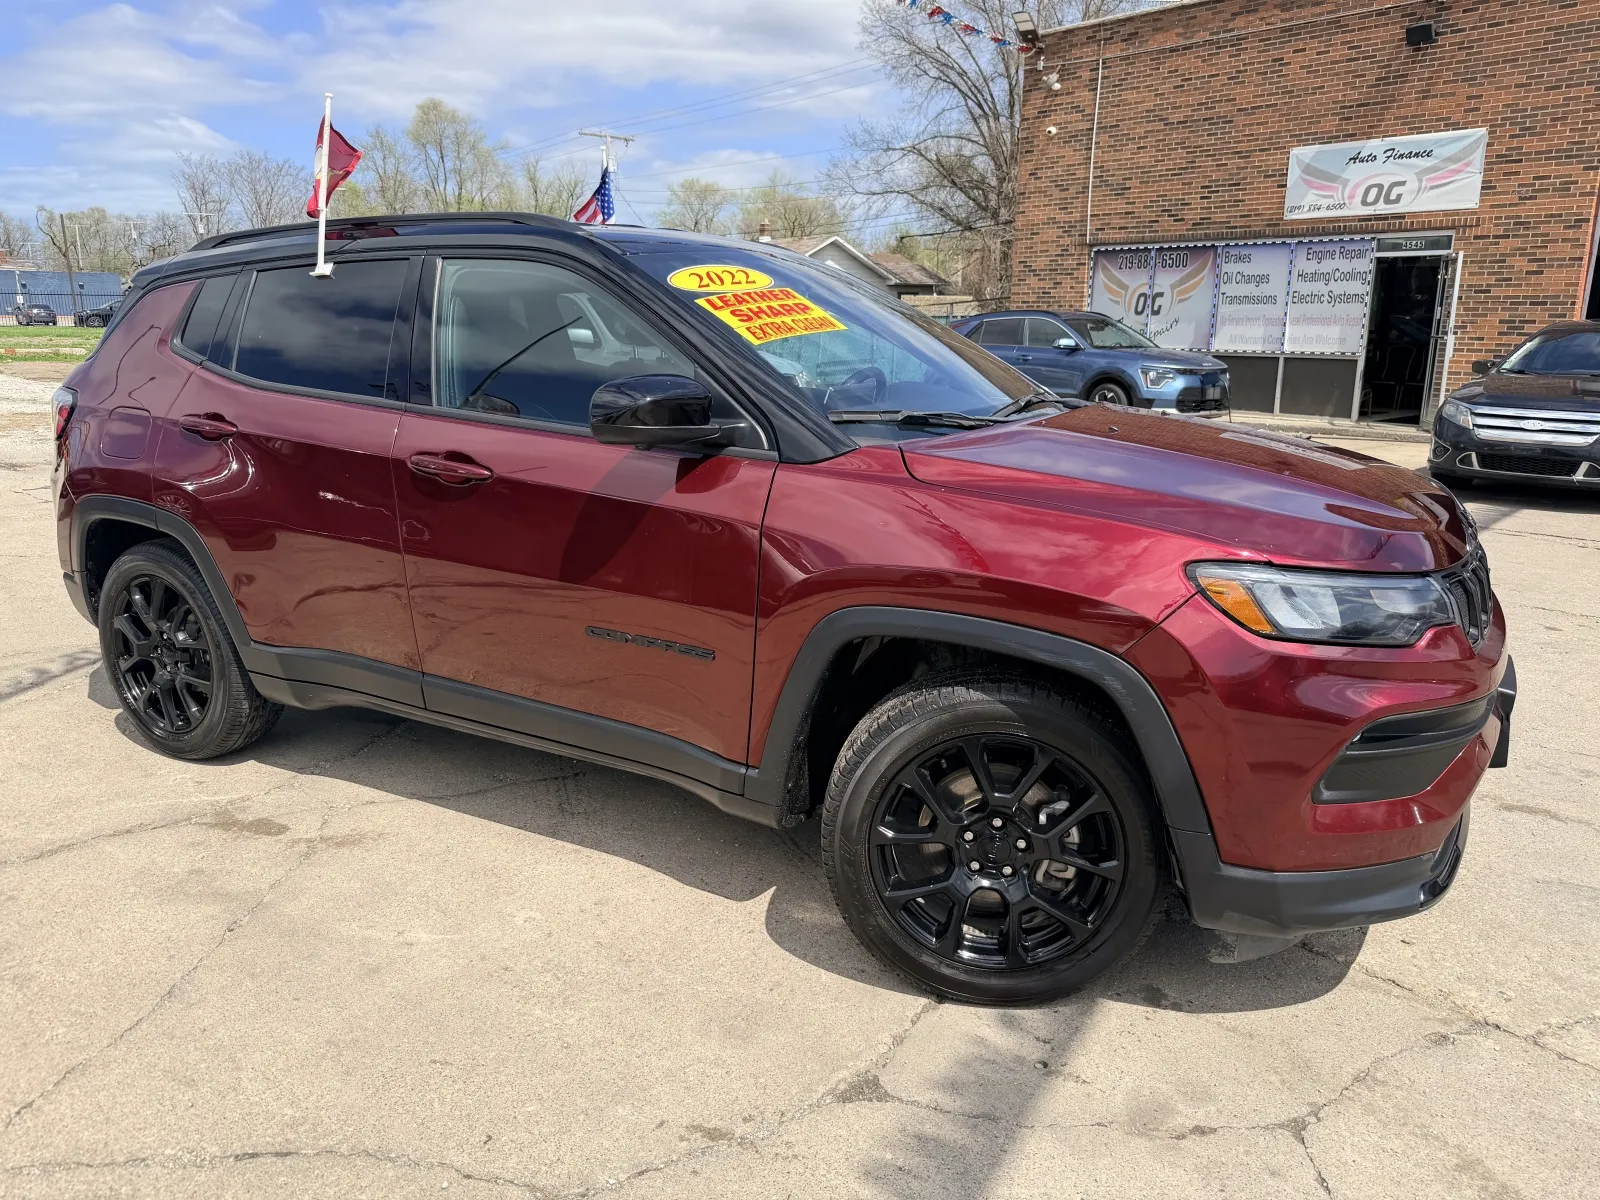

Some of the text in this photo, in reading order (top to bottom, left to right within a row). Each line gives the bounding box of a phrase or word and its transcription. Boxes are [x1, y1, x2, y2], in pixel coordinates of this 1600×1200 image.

[1345, 147, 1434, 165] Auto Finance
[1360, 180, 1408, 206] OG
[1286, 202, 1346, 213] (219) 884-6500
[1403, 240, 1425, 249] 4545
[1224, 251, 1252, 264] Brakes
[1306, 245, 1369, 264] Engine Repair
[688, 269, 757, 289] 2022
[1222, 270, 1270, 287] Oil Changes
[1297, 267, 1368, 286] Heating/Cooling
[704, 288, 799, 311] LEATHER
[1133, 291, 1165, 316] OG
[1221, 292, 1278, 305] Transmissions
[1291, 289, 1366, 307] Electric Systems
[729, 302, 815, 323] SHARP
[1302, 312, 1332, 326] Professional
[745, 315, 837, 341] EXTRA CLEAN
[1238, 334, 1266, 347] Warranty
[1315, 333, 1347, 346] Welcome
